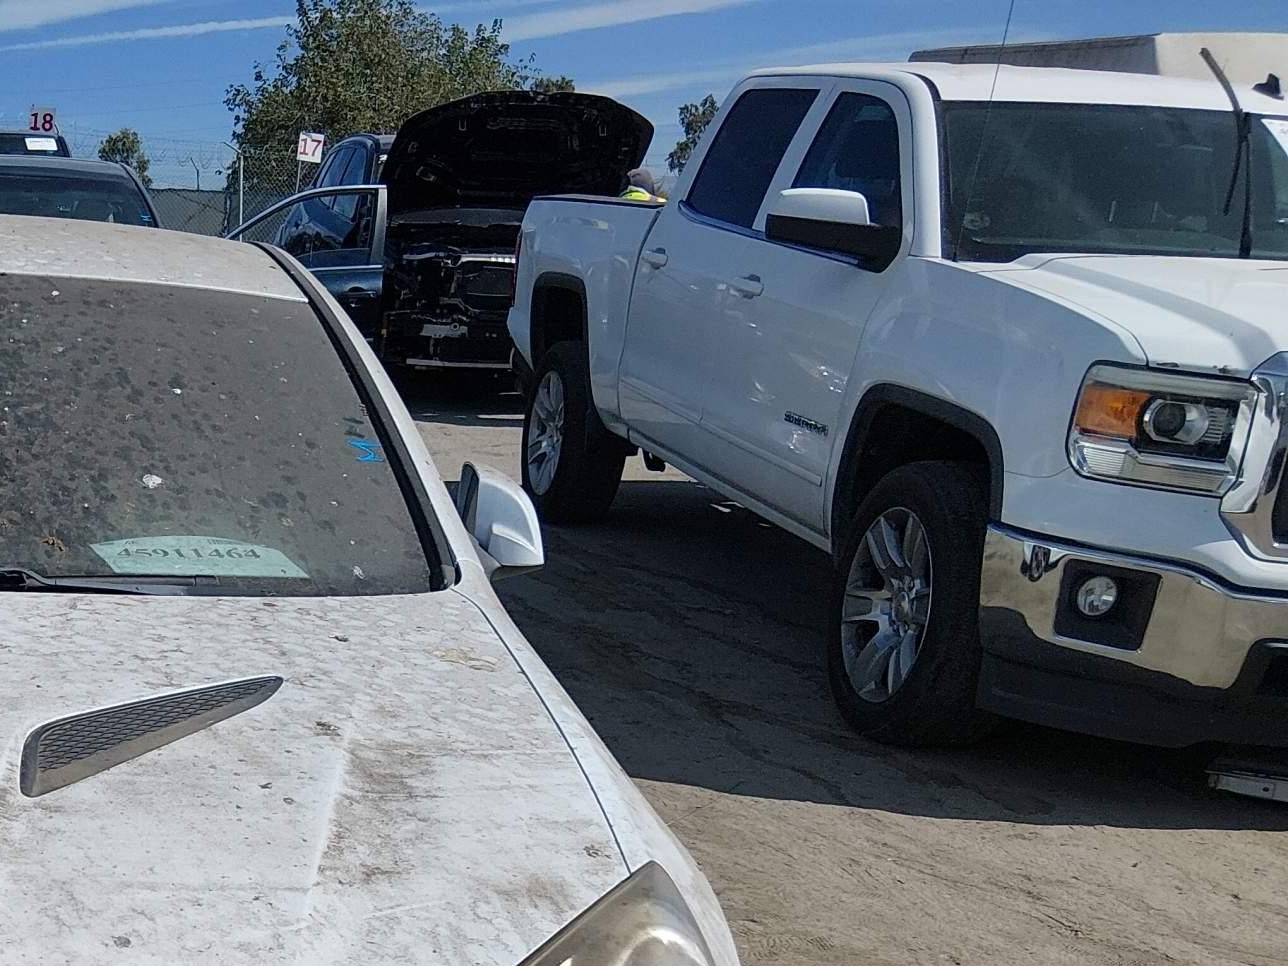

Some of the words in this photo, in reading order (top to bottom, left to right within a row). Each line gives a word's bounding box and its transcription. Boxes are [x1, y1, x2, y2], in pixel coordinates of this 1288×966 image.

[29, 112, 54, 131] 18
[299, 137, 323, 157] 17
[116, 547, 262, 559] 45911464
